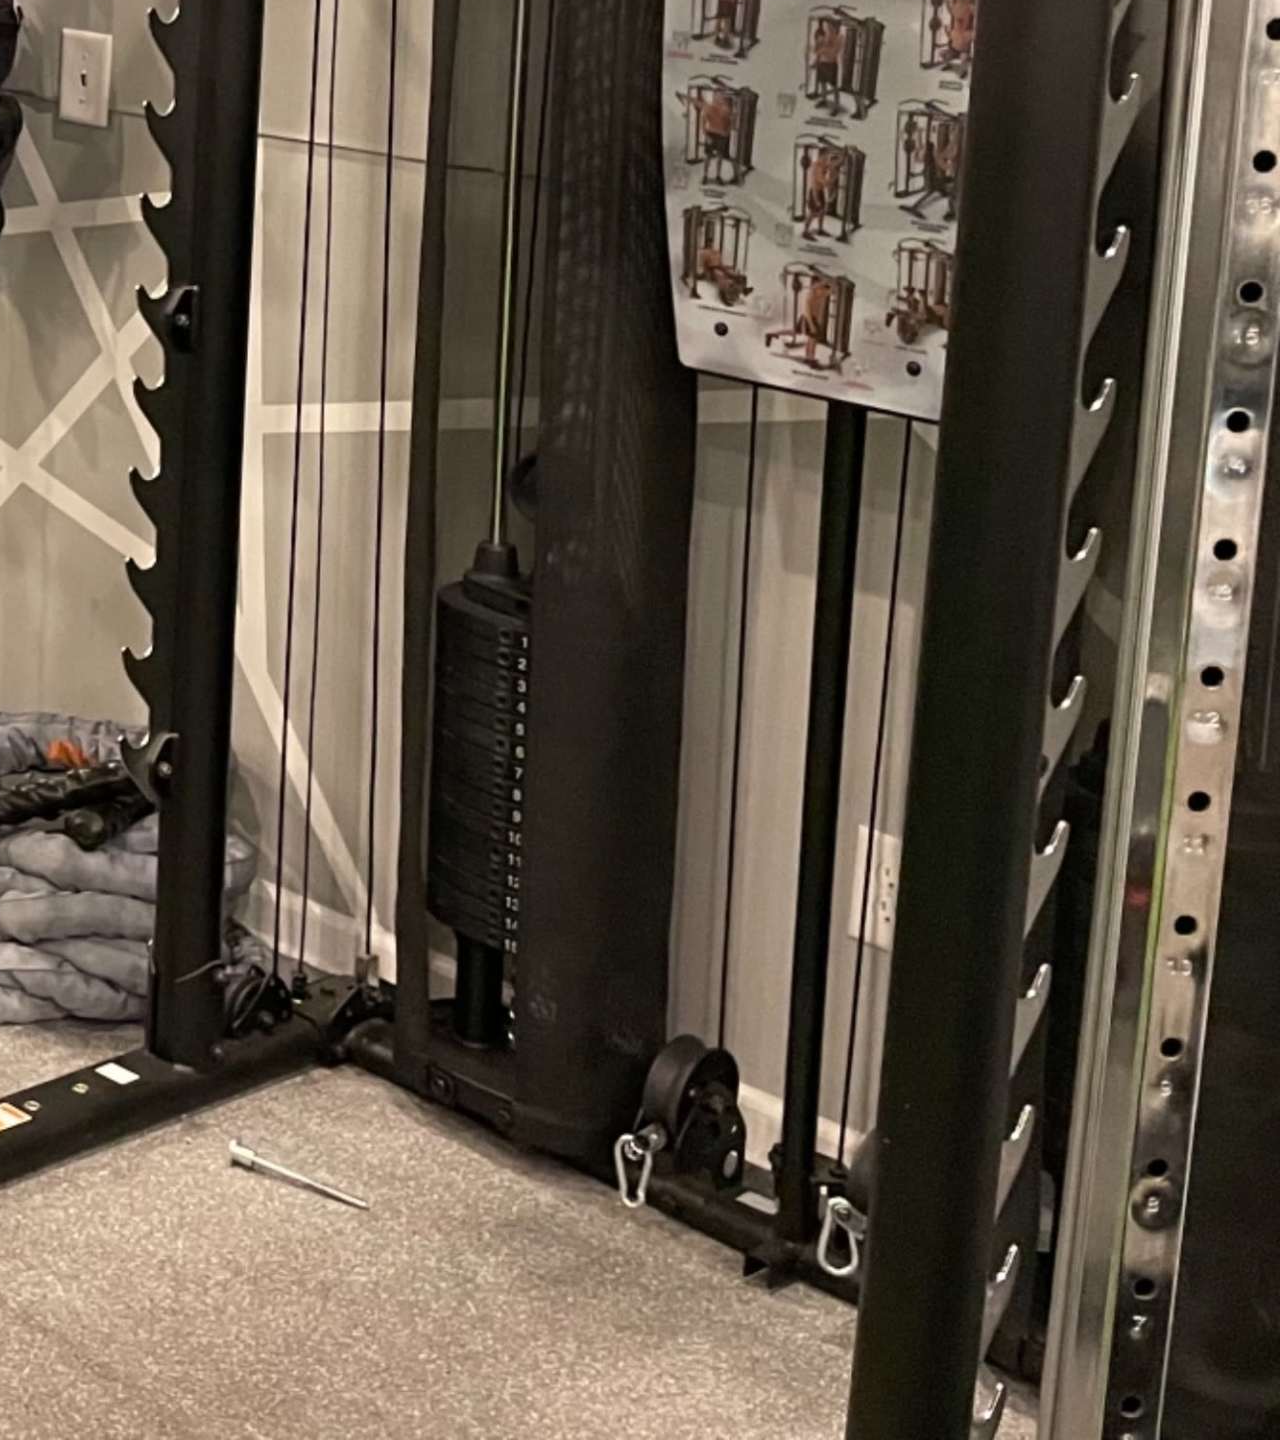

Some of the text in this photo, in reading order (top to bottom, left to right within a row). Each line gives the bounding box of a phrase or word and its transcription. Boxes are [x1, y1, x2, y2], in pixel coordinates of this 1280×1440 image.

[521, 637, 528, 648] 1
[518, 659, 527, 671] 2
[517, 680, 527, 692] 3
[517, 702, 526, 714] 4
[515, 745, 525, 758] 6
[514, 767, 524, 779] 7
